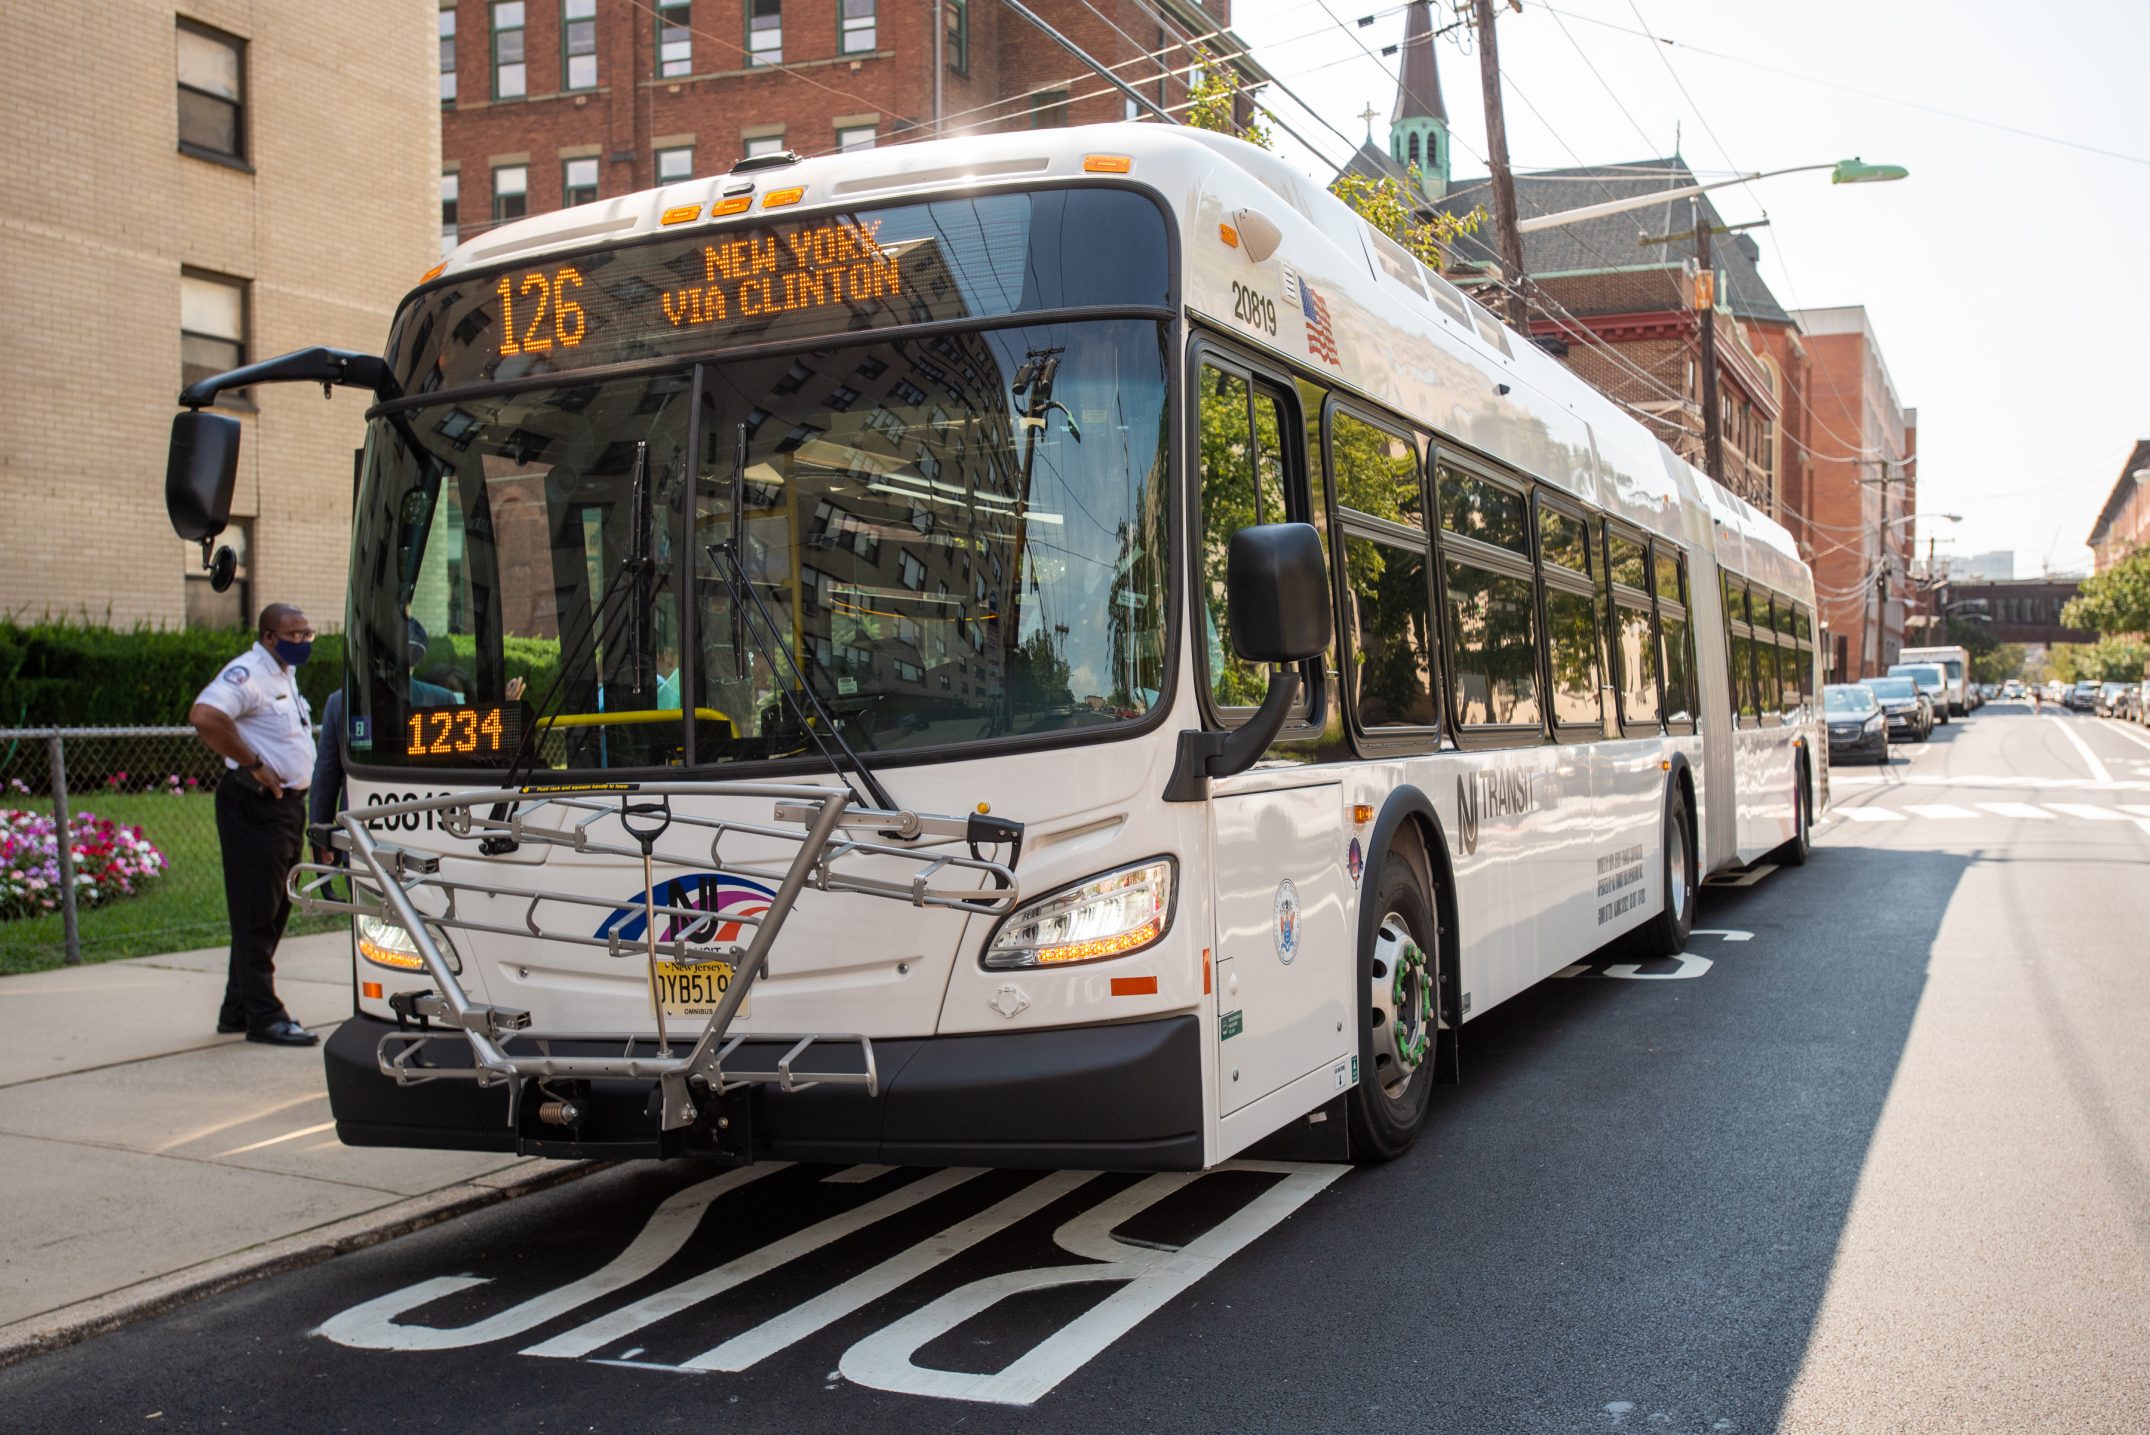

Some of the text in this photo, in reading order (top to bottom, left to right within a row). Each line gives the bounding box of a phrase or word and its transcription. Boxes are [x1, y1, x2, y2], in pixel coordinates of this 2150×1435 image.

[704, 219, 883, 282] NEW YORK
[496, 265, 586, 356] 126
[662, 258, 900, 327] VIA CLINTON
[1232, 280, 1277, 336] 20819
[407, 707, 503, 755] 1234
[1457, 766, 1535, 855] NJ TRANSIT
[669, 877, 719, 944] NJ
[671, 963, 722, 974] New Jersey
